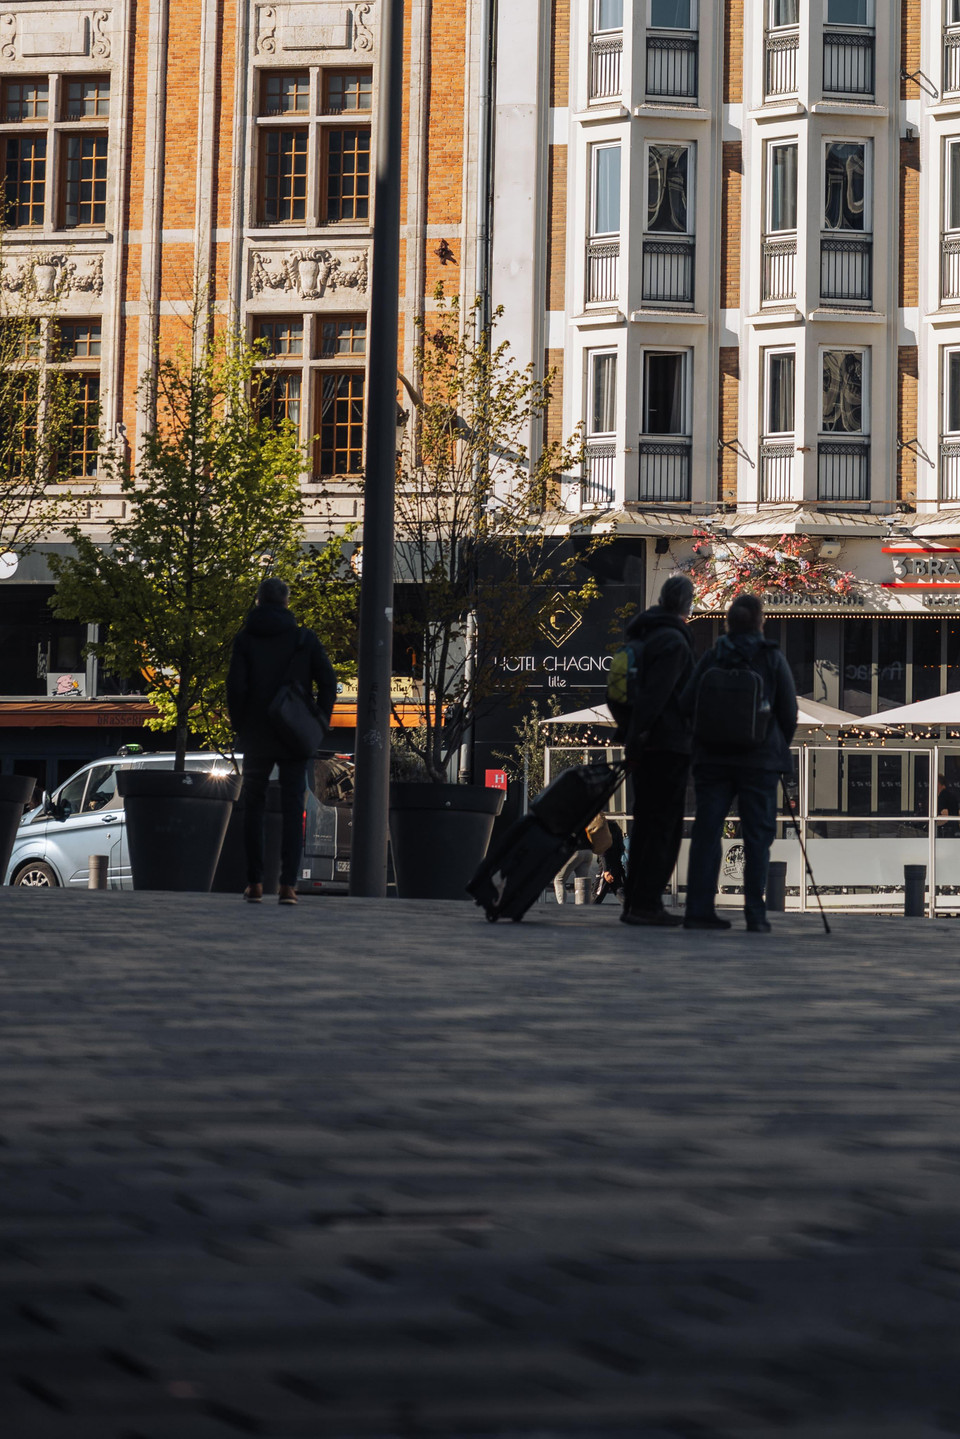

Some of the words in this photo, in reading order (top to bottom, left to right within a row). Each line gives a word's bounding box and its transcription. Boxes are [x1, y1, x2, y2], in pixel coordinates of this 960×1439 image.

[891, 556, 908, 579] 3
[494, 656, 537, 672] HOTEL
[542, 655, 615, 672] CHAGNO
[494, 773, 505, 784] H
